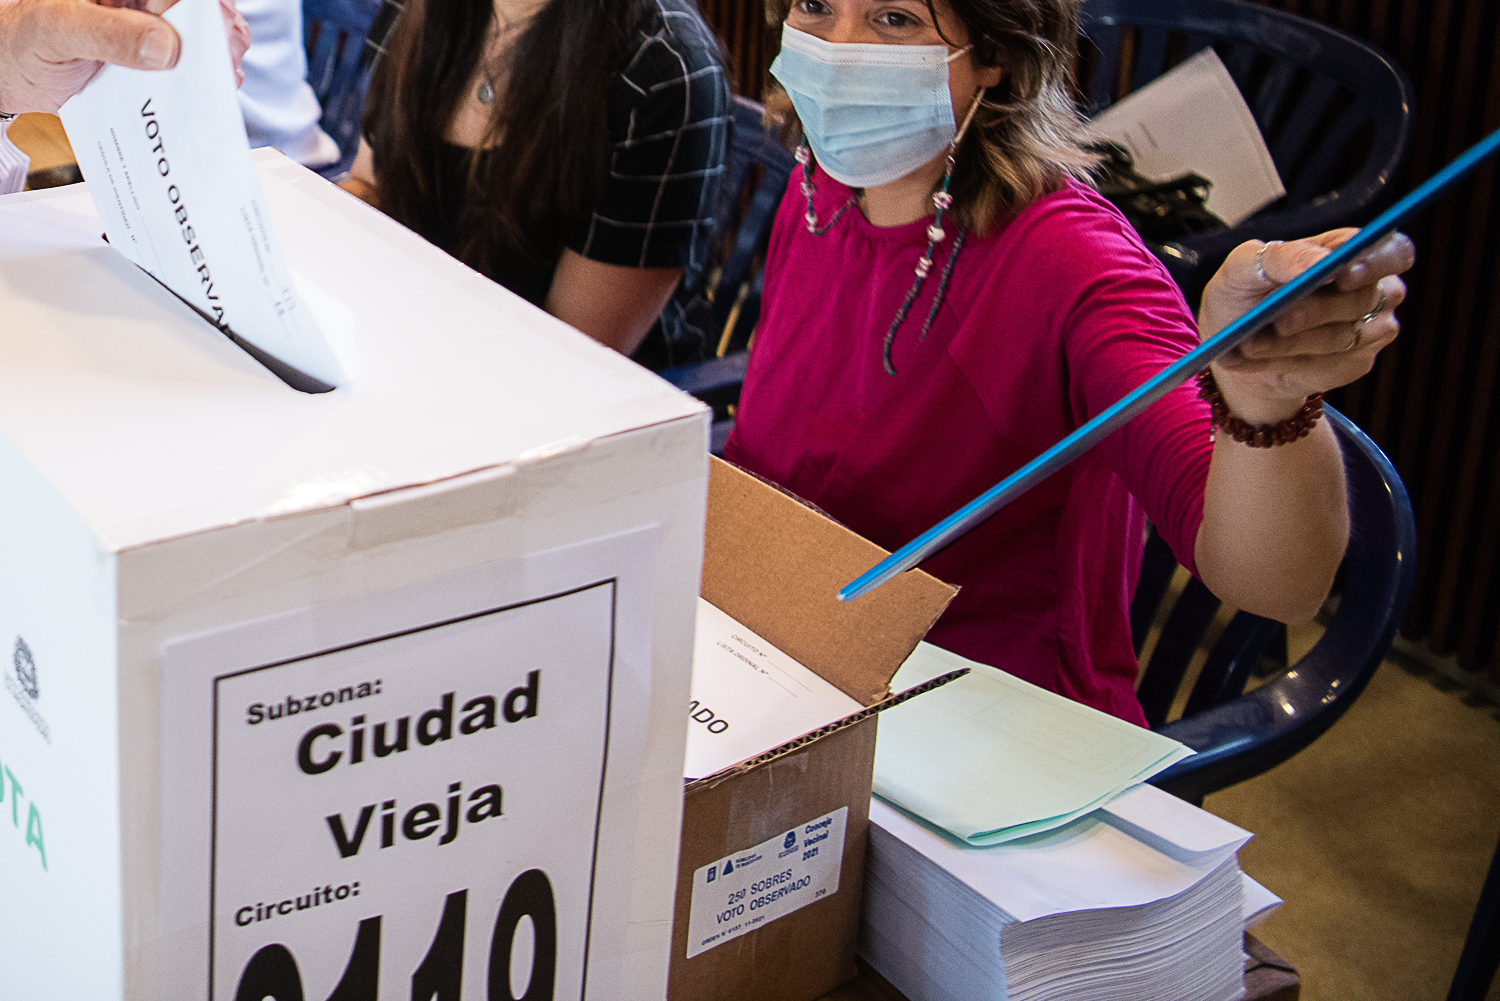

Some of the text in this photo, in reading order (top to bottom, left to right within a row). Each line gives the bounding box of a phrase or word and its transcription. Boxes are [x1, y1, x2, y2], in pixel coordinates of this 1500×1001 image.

[141, 97, 230, 331] VOTO OBSERVA
[246, 678, 383, 725] Subzona:
[295, 669, 542, 775] Ciudad
[325, 781, 505, 859] Vieja
[805, 817, 833, 834] Concejo
[234, 881, 361, 927] Circuito:
[716, 875, 811, 924] VOTO OBSERVADO
[728, 868, 792, 905] 250 SOBRES
